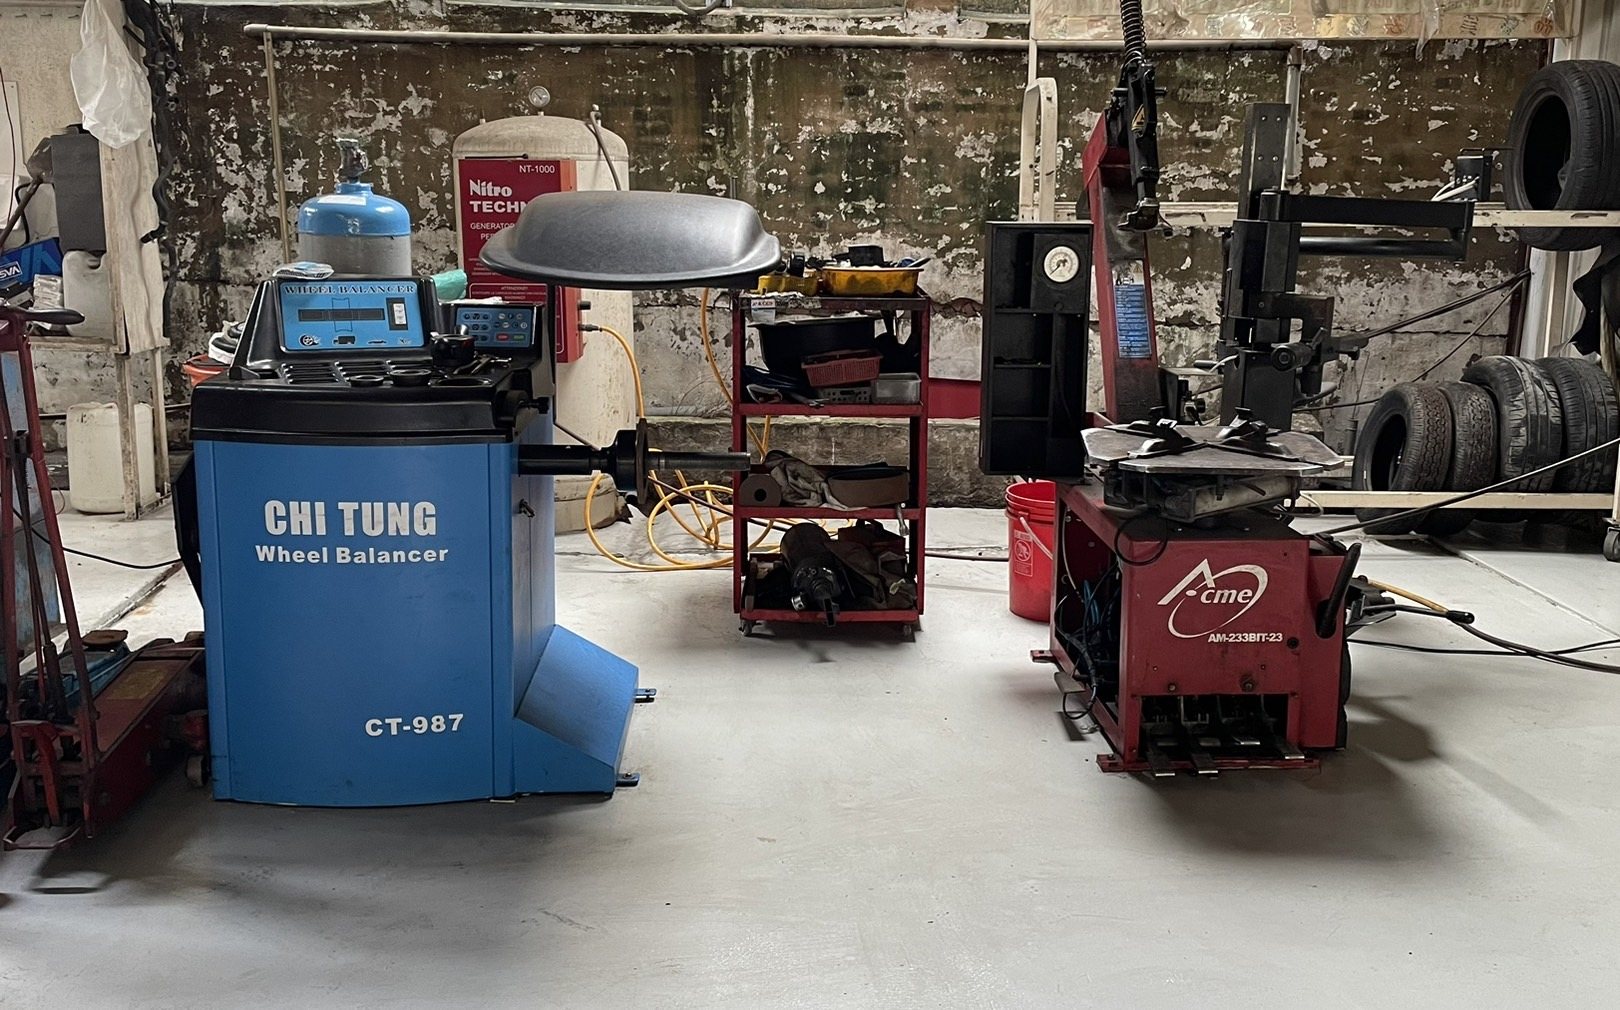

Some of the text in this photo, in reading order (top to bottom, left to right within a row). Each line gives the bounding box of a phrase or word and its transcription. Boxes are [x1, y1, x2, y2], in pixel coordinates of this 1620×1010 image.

[519, 165, 555, 174] NT-1000
[469, 179, 513, 197] Nitro
[284, 285, 414, 295] WHEEL BALANCER
[264, 500, 436, 537] CHI TUNG
[255, 545, 449, 565] Wheel Balancer
[1157, 558, 1253, 605] Acme
[1207, 632, 1284, 643] AM-233BIT-23
[365, 713, 464, 737] CT-987
